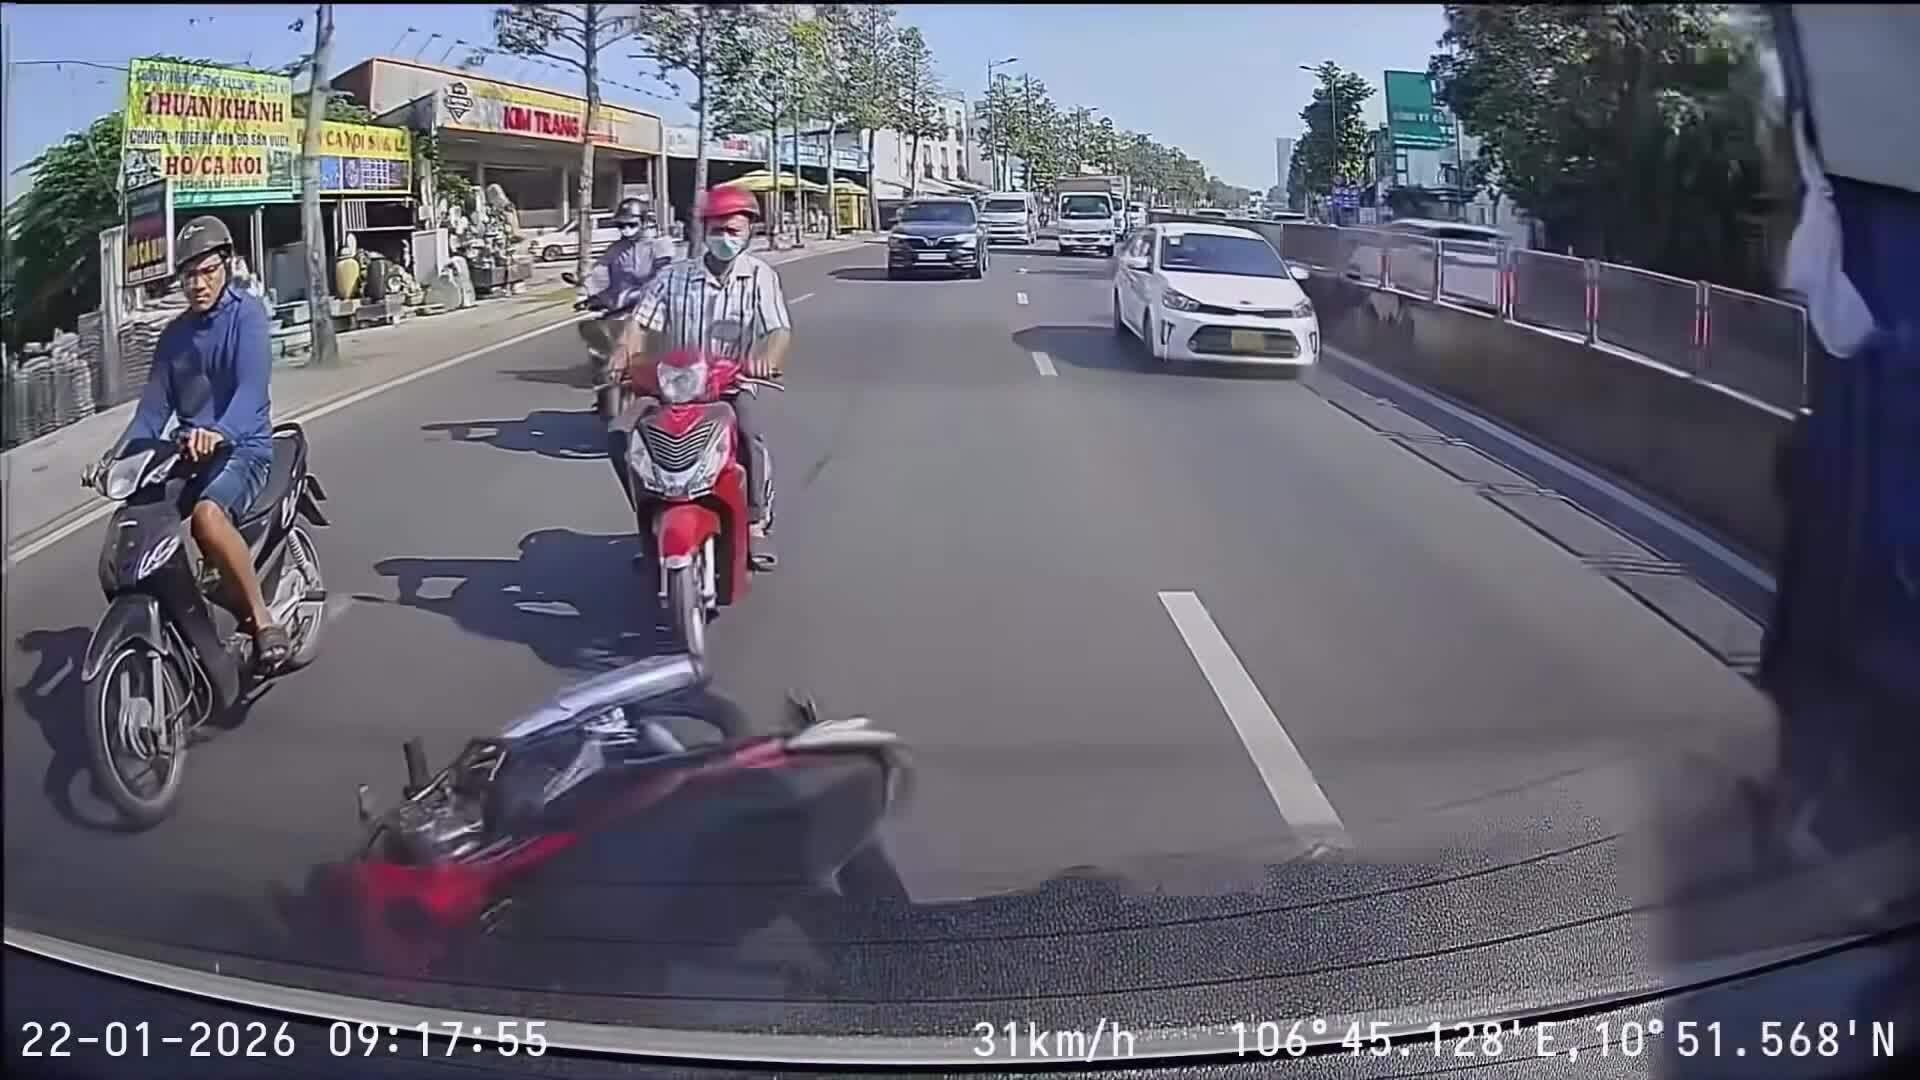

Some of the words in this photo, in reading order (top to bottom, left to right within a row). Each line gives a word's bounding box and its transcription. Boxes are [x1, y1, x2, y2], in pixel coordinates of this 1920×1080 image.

[503, 106, 531, 131] KIM
[534, 110, 579, 138] TRANG
[231, 155, 262, 175] KOI
